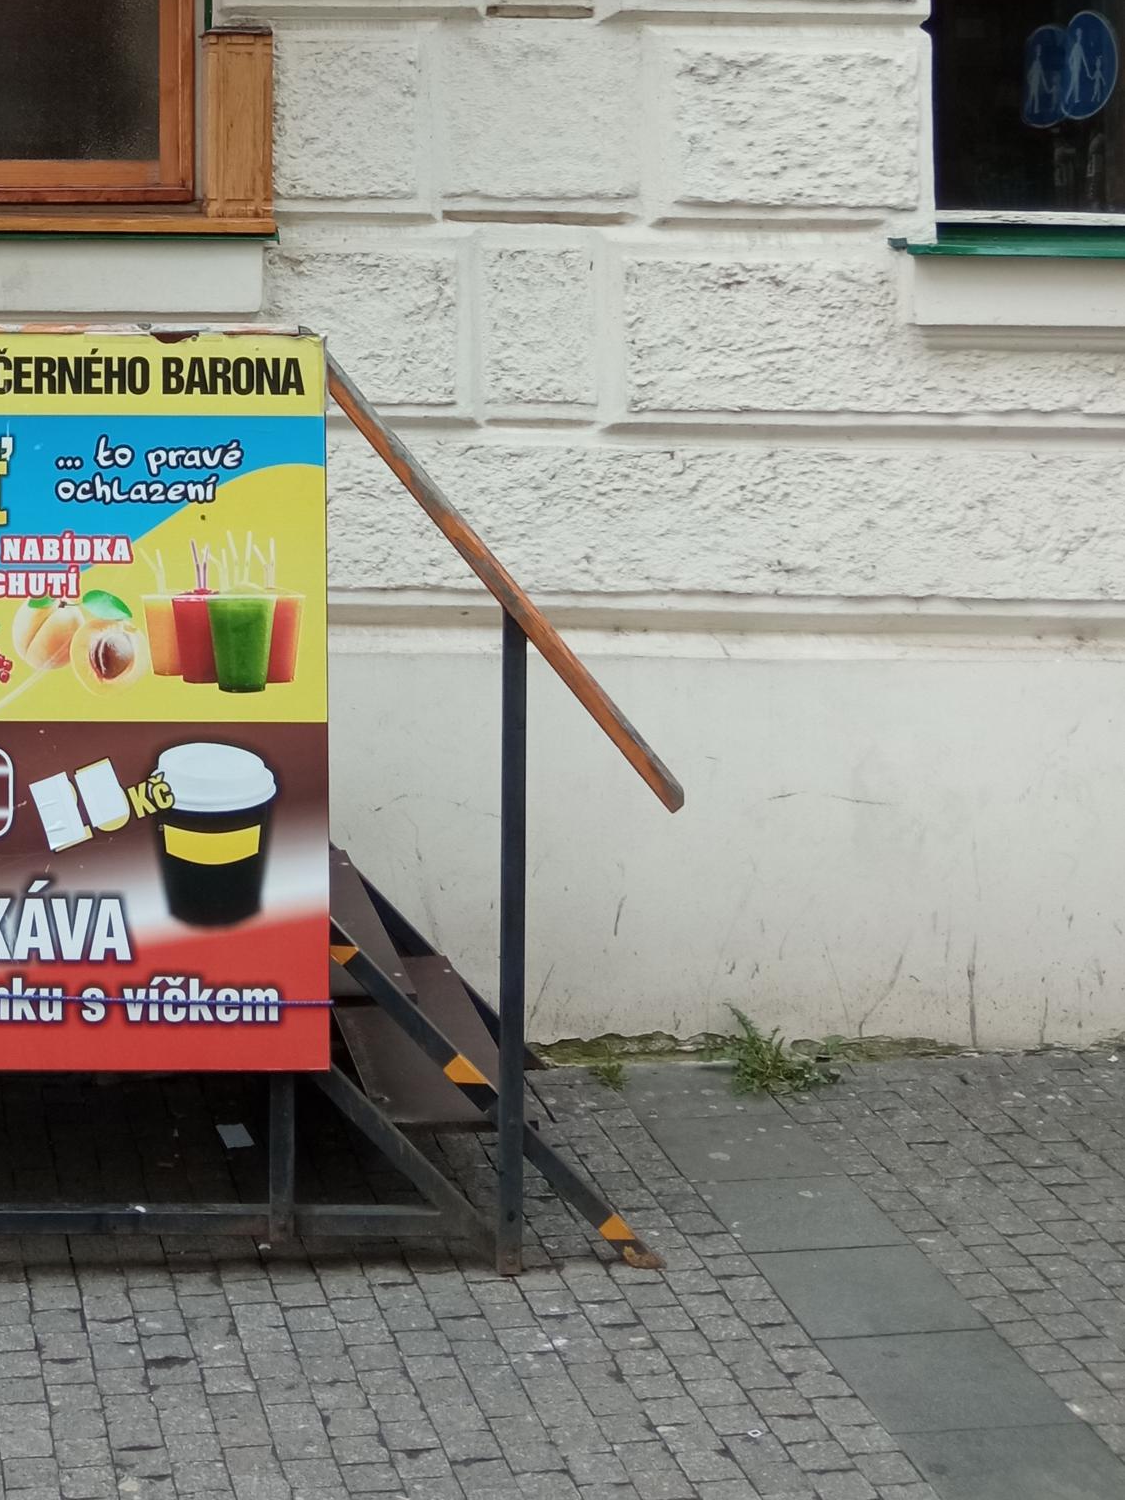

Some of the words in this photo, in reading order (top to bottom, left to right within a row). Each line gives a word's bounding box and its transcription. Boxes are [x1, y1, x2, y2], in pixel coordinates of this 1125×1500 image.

[163, 355, 306, 396] BARONA
[97, 435, 131, 470] to
[146, 441, 244, 480] pravé
[1, 532, 134, 566] NABÍDKA
[82, 988, 108, 1023] s
[122, 976, 281, 1023] víčkem
